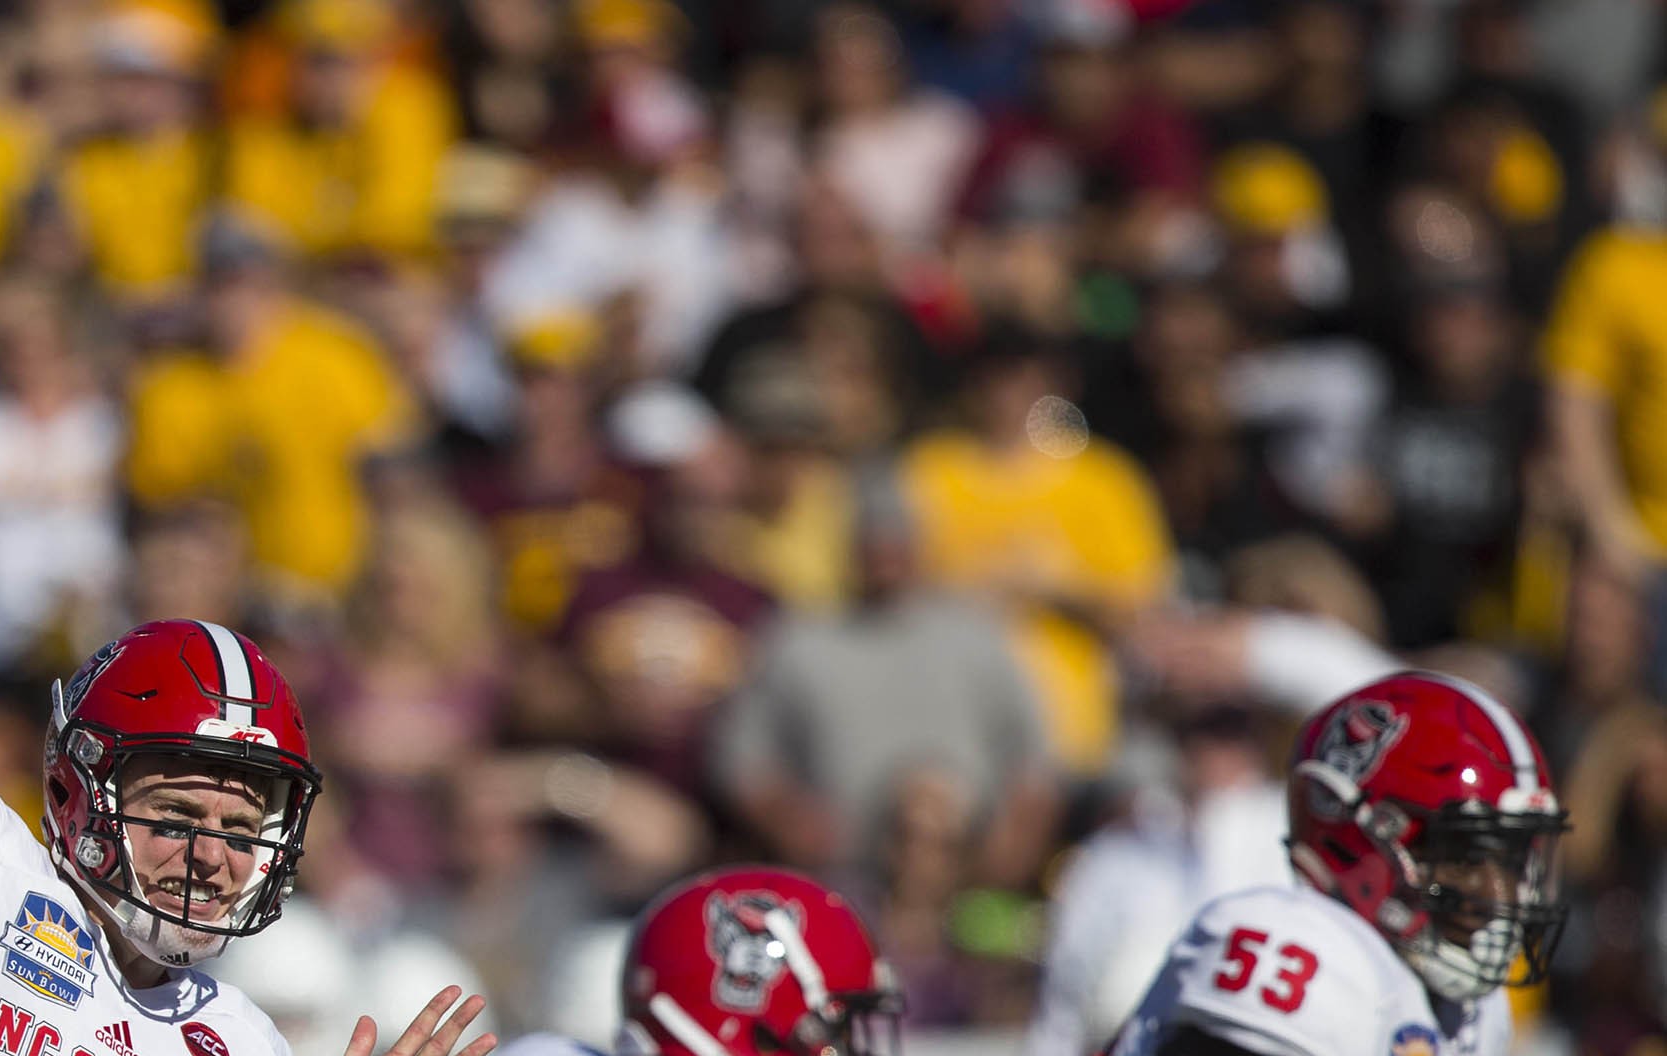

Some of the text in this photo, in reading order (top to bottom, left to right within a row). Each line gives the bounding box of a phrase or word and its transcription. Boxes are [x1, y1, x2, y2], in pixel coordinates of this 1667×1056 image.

[8, 959, 76, 1005] SUN BOWL
[35, 946, 86, 985] HYUNDAI
[1214, 927, 1319, 1014] 53
